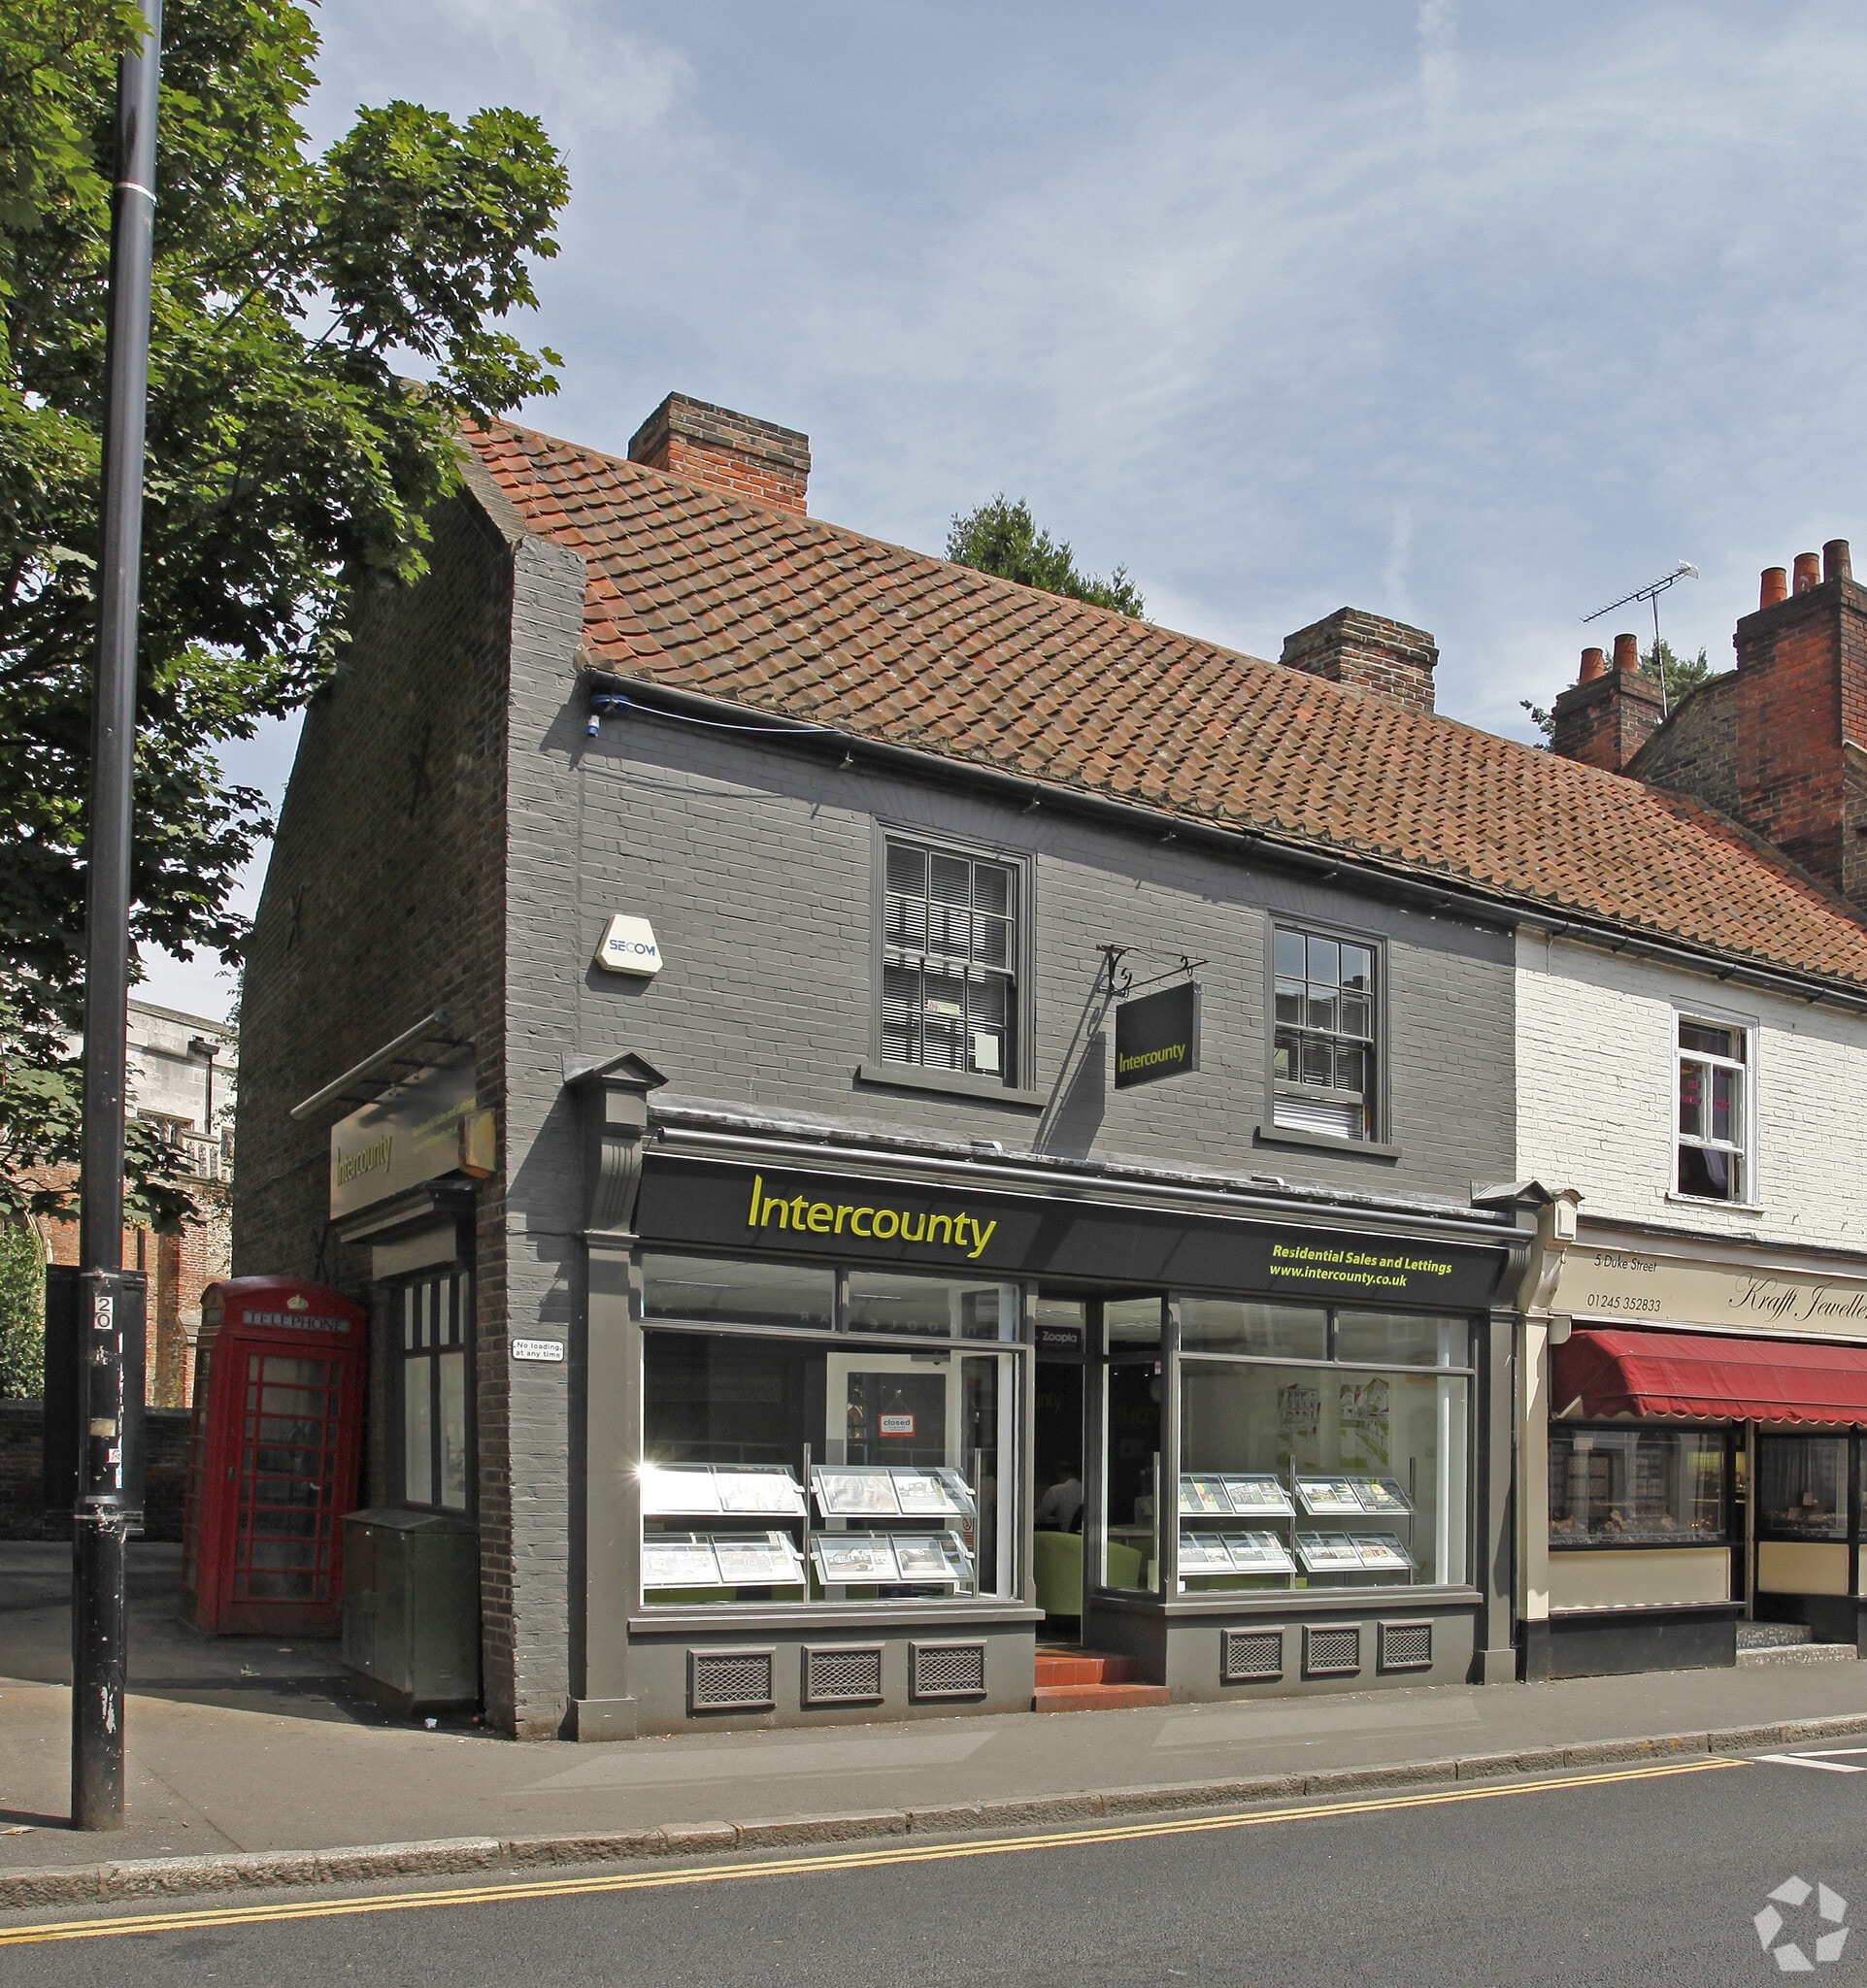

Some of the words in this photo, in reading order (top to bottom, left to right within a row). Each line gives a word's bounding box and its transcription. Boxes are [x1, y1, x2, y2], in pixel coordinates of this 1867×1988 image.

[609, 939, 655, 956] SECOM
[1119, 1044, 1185, 1073] Intercounty
[336, 1135, 392, 1187] Intercounty
[748, 1174, 997, 1258] Intercounty
[1272, 1244, 1344, 1263] Residential
[1345, 1251, 1378, 1267] Sales
[1379, 1256, 1404, 1269] and
[1404, 1258, 1453, 1276] Lettings
[1593, 1254, 1603, 1267] 5
[1604, 1254, 1628, 1270] Duke
[1630, 1257, 1658, 1273] Street
[1269, 1265, 1408, 1287] www.intercounty.co.uk
[1586, 1293, 1620, 1309] 01245
[1622, 1297, 1661, 1312] 352833
[1728, 1272, 1798, 1323] Krafft
[248, 1311, 343, 1332] TELEPHONE
[531, 1342, 560, 1351] loading
[1042, 1331, 1078, 1343] Zoopla
